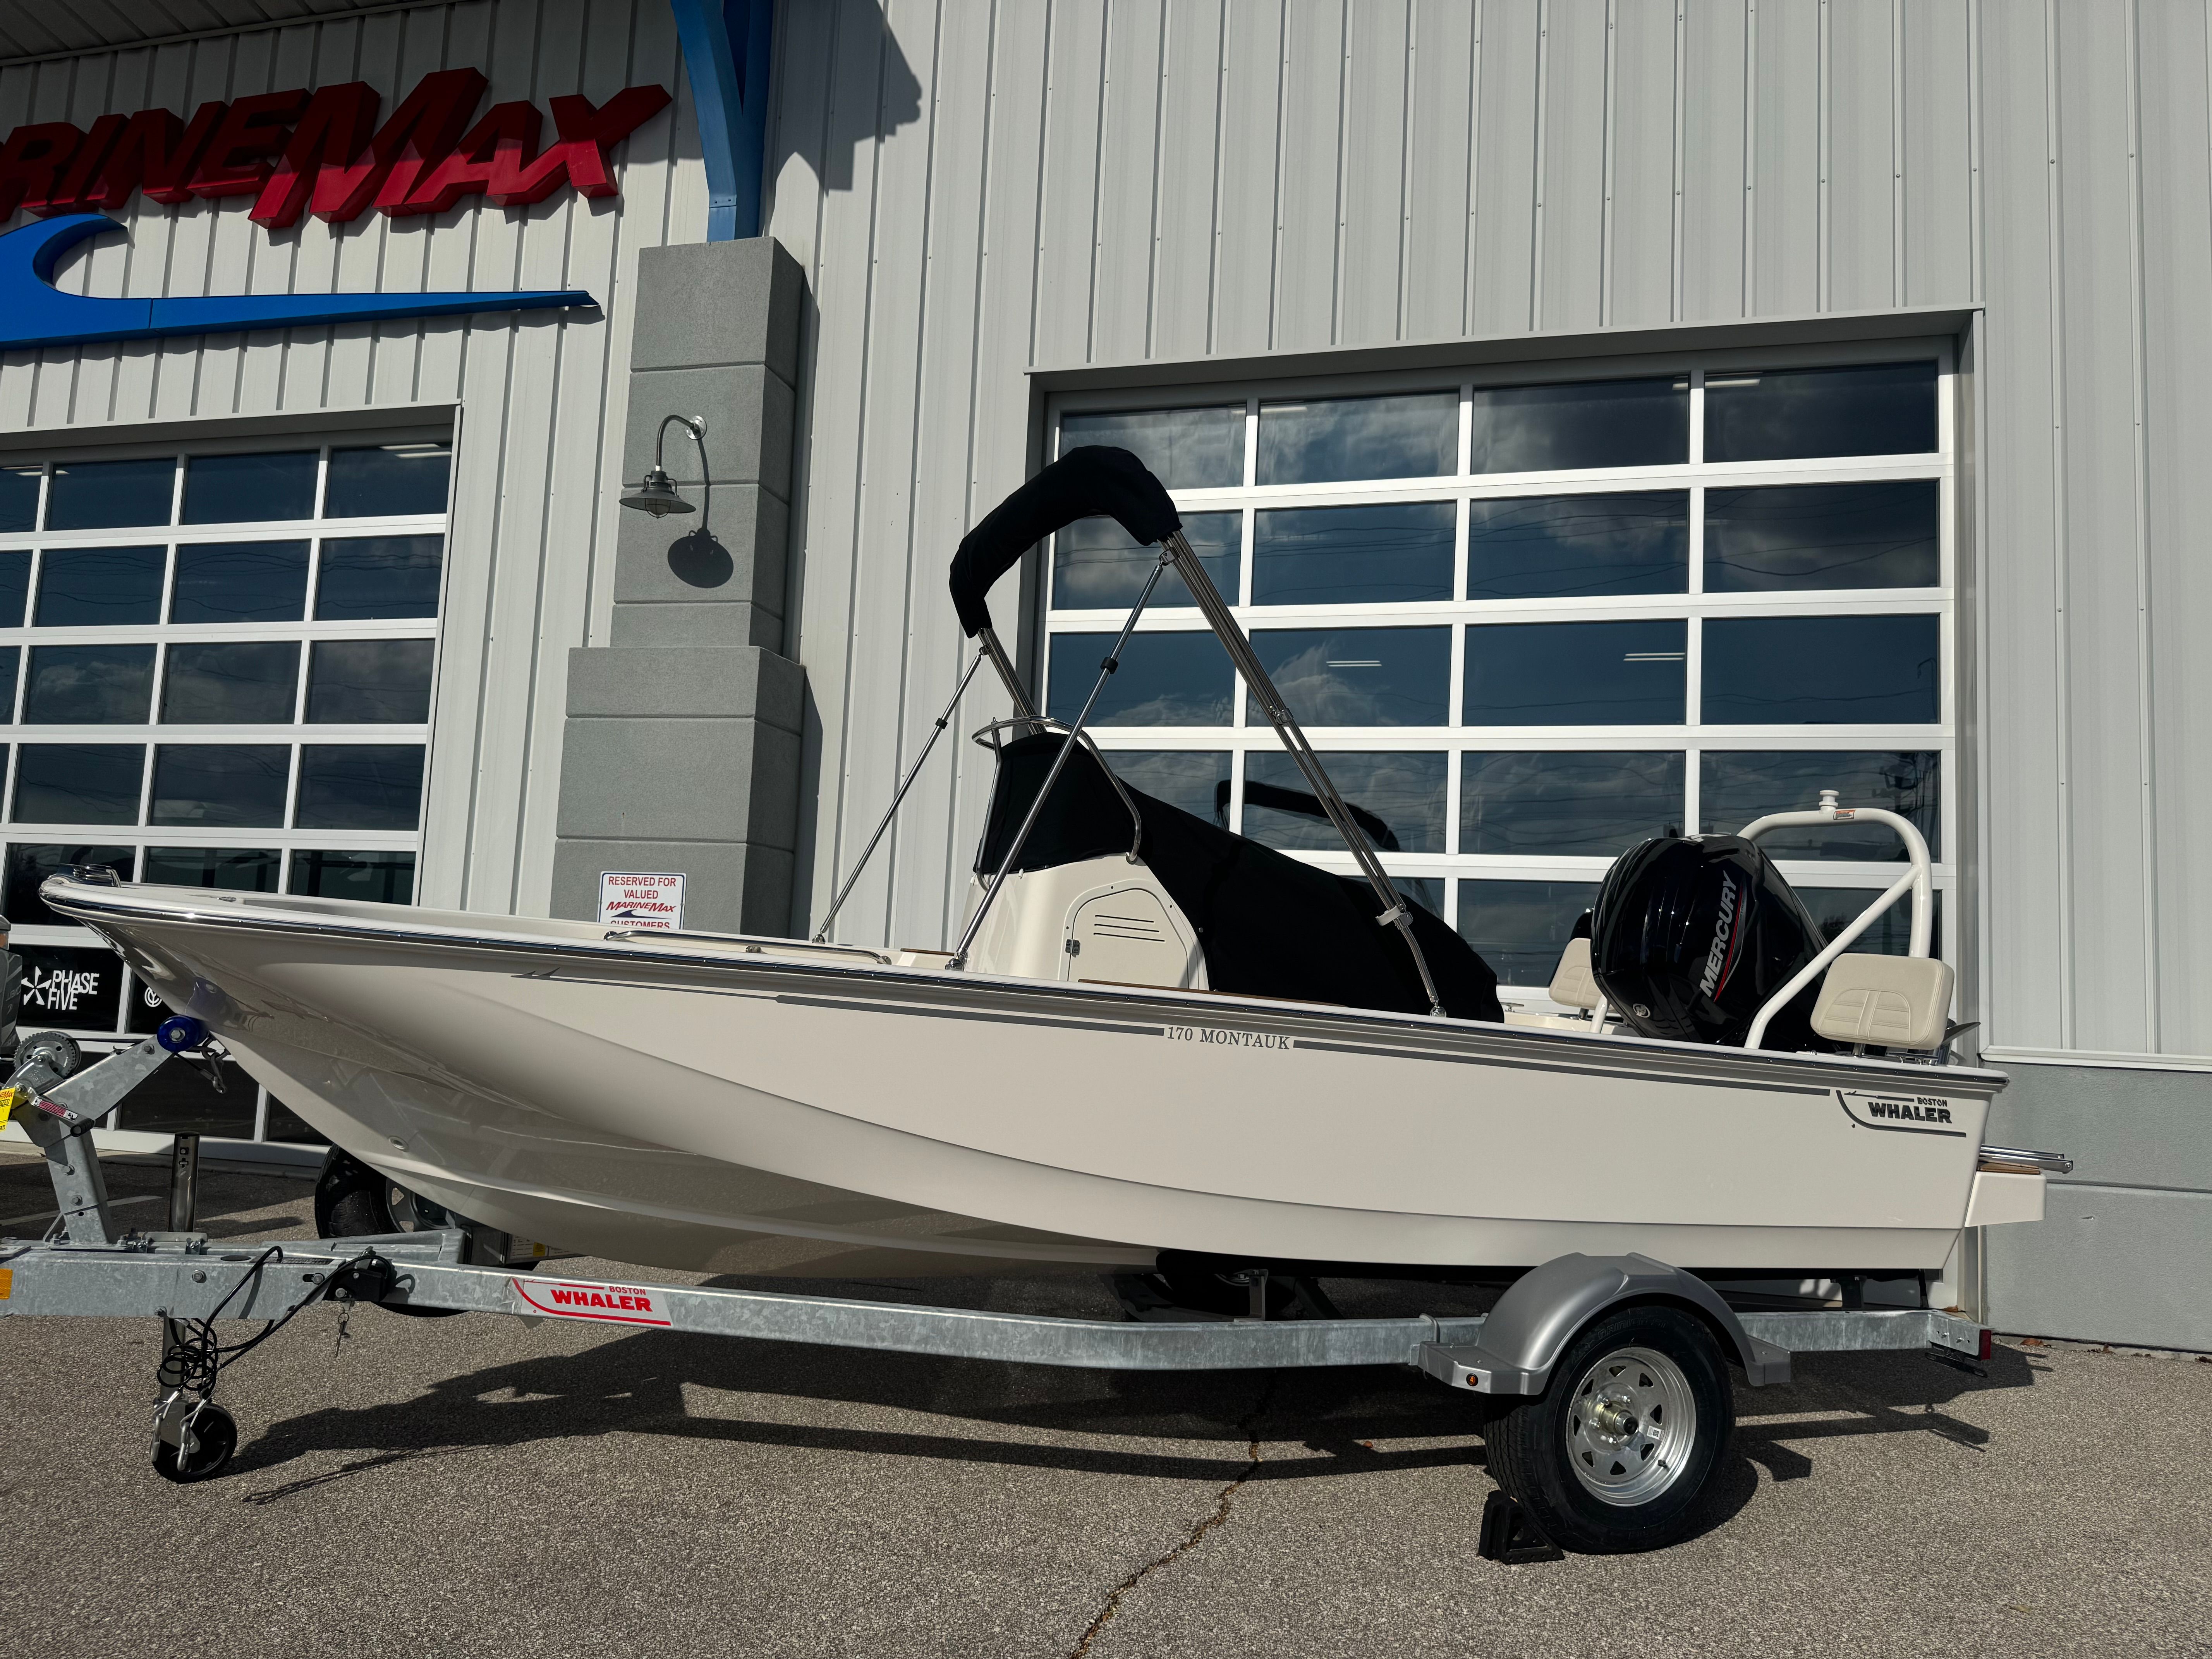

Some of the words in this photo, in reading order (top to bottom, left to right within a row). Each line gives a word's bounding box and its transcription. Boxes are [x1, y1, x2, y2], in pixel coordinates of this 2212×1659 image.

[0, 67, 673, 229] RINEMAX
[608, 876, 655, 886] RESERVED
[658, 878, 676, 886] FOR
[624, 890, 658, 899] VALUED
[1699, 870, 1736, 998] MERCURY
[52, 970, 100, 994] PHASE
[47, 988, 78, 1010] FIVE
[1167, 1027, 1193, 1041] 170
[1199, 1029, 1290, 1049] MONTAUK
[1868, 1102, 1952, 1123] WHALER
[1917, 1097, 1948, 1107] BOSTON
[550, 1289, 653, 1312] WHALER
[609, 1286, 646, 1295] BOSTON
